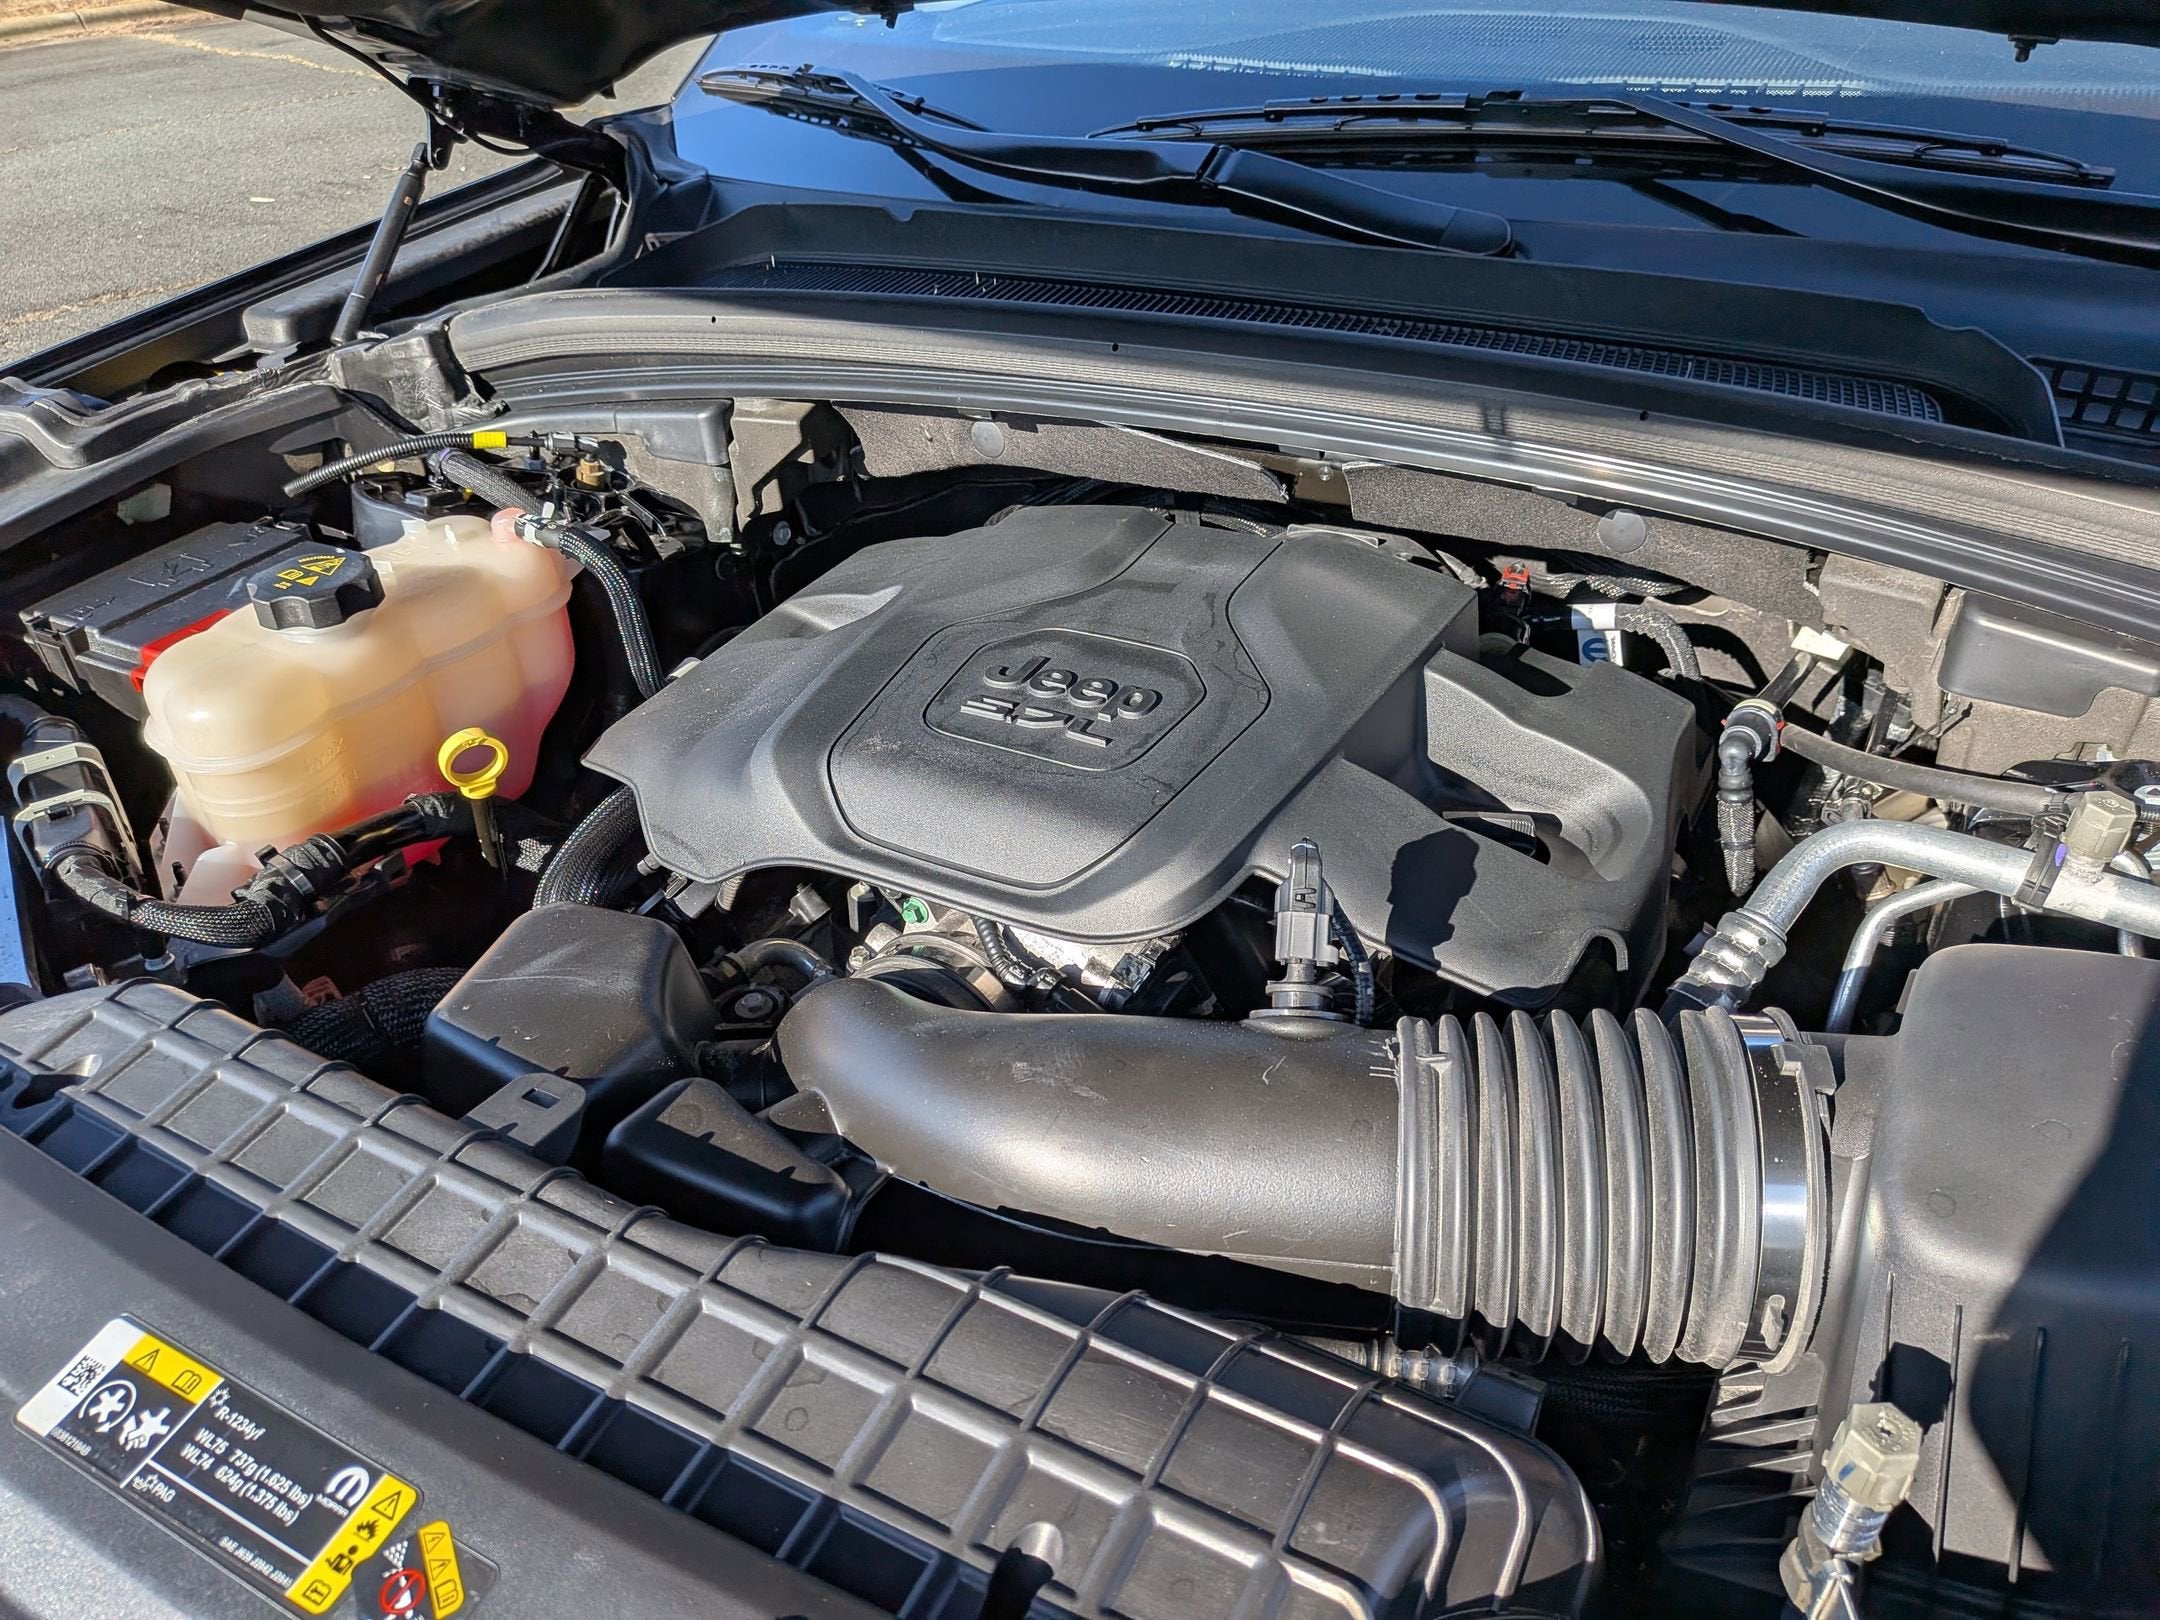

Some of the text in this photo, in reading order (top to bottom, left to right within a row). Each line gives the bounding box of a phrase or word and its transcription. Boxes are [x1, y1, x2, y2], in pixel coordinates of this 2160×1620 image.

[983, 656, 1163, 722] Jeep
[960, 695, 1113, 748] 5.7L
[214, 1404, 267, 1442] R-1234yf
[152, 1481, 176, 1502] PAG
[180, 1443, 299, 1527] WL74 624g (1.375 lbs)
[194, 1427, 314, 1509] WL75 737g (1.625 lbs)
[219, 1536, 239, 1554] SAE
